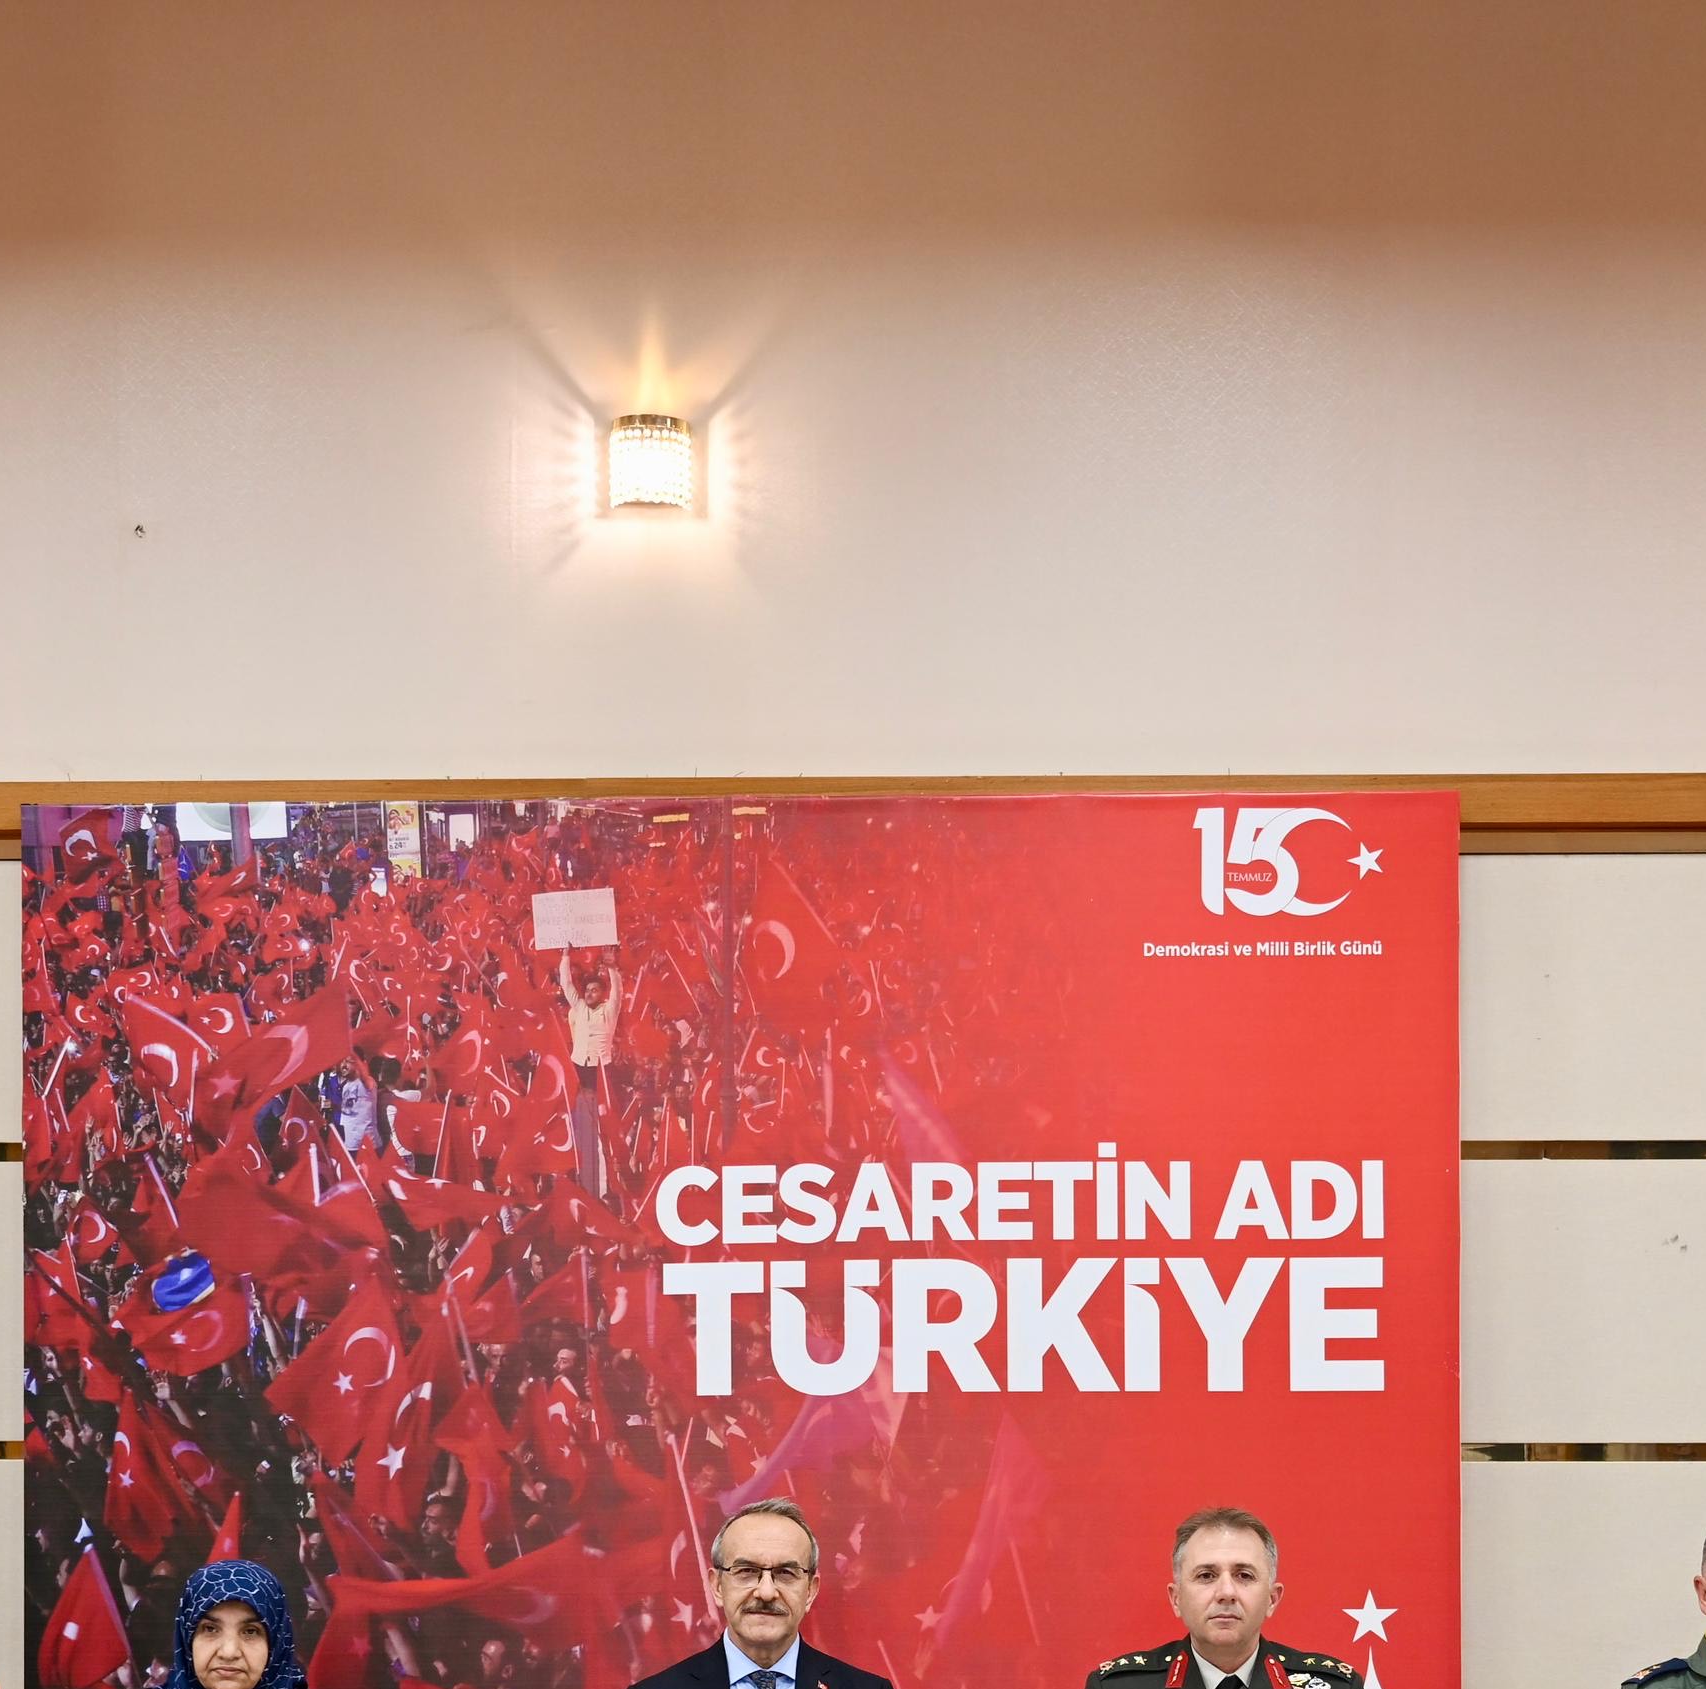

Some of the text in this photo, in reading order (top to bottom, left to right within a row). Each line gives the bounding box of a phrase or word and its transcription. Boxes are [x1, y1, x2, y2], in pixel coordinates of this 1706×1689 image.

[1227, 871, 1273, 882] TEMMUZ
[1143, 939, 1383, 957] Demokrasi ve Milli Birlik Günü
[655, 1141, 1385, 1247] CESARETİN ADI
[663, 1256, 1386, 1398] TÜRKİYE
